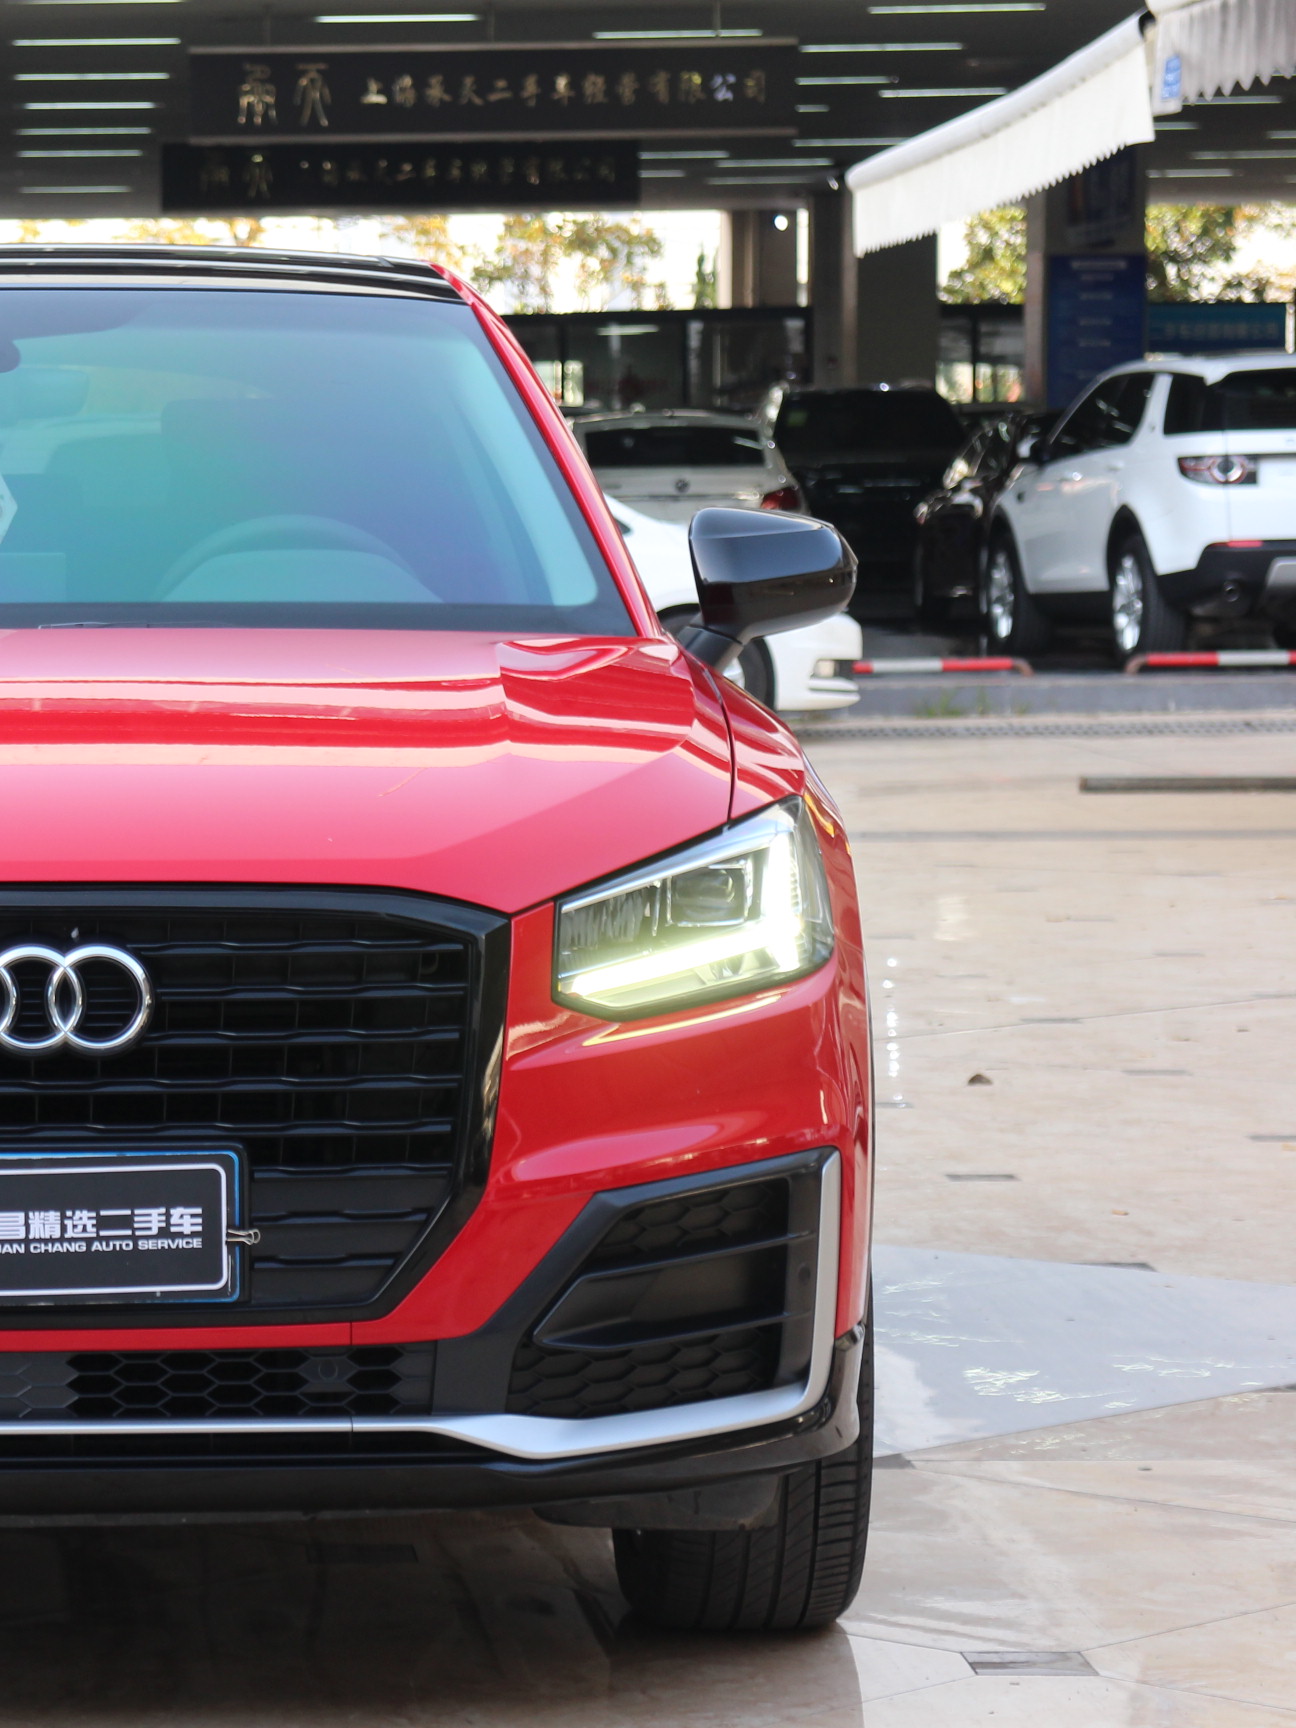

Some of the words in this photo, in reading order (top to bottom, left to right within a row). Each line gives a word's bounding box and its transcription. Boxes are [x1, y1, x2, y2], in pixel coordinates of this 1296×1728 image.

[30, 1241, 87, 1254] CHANG
[91, 1240, 133, 1252] AUTO
[137, 1237, 203, 1251] SERVICE
